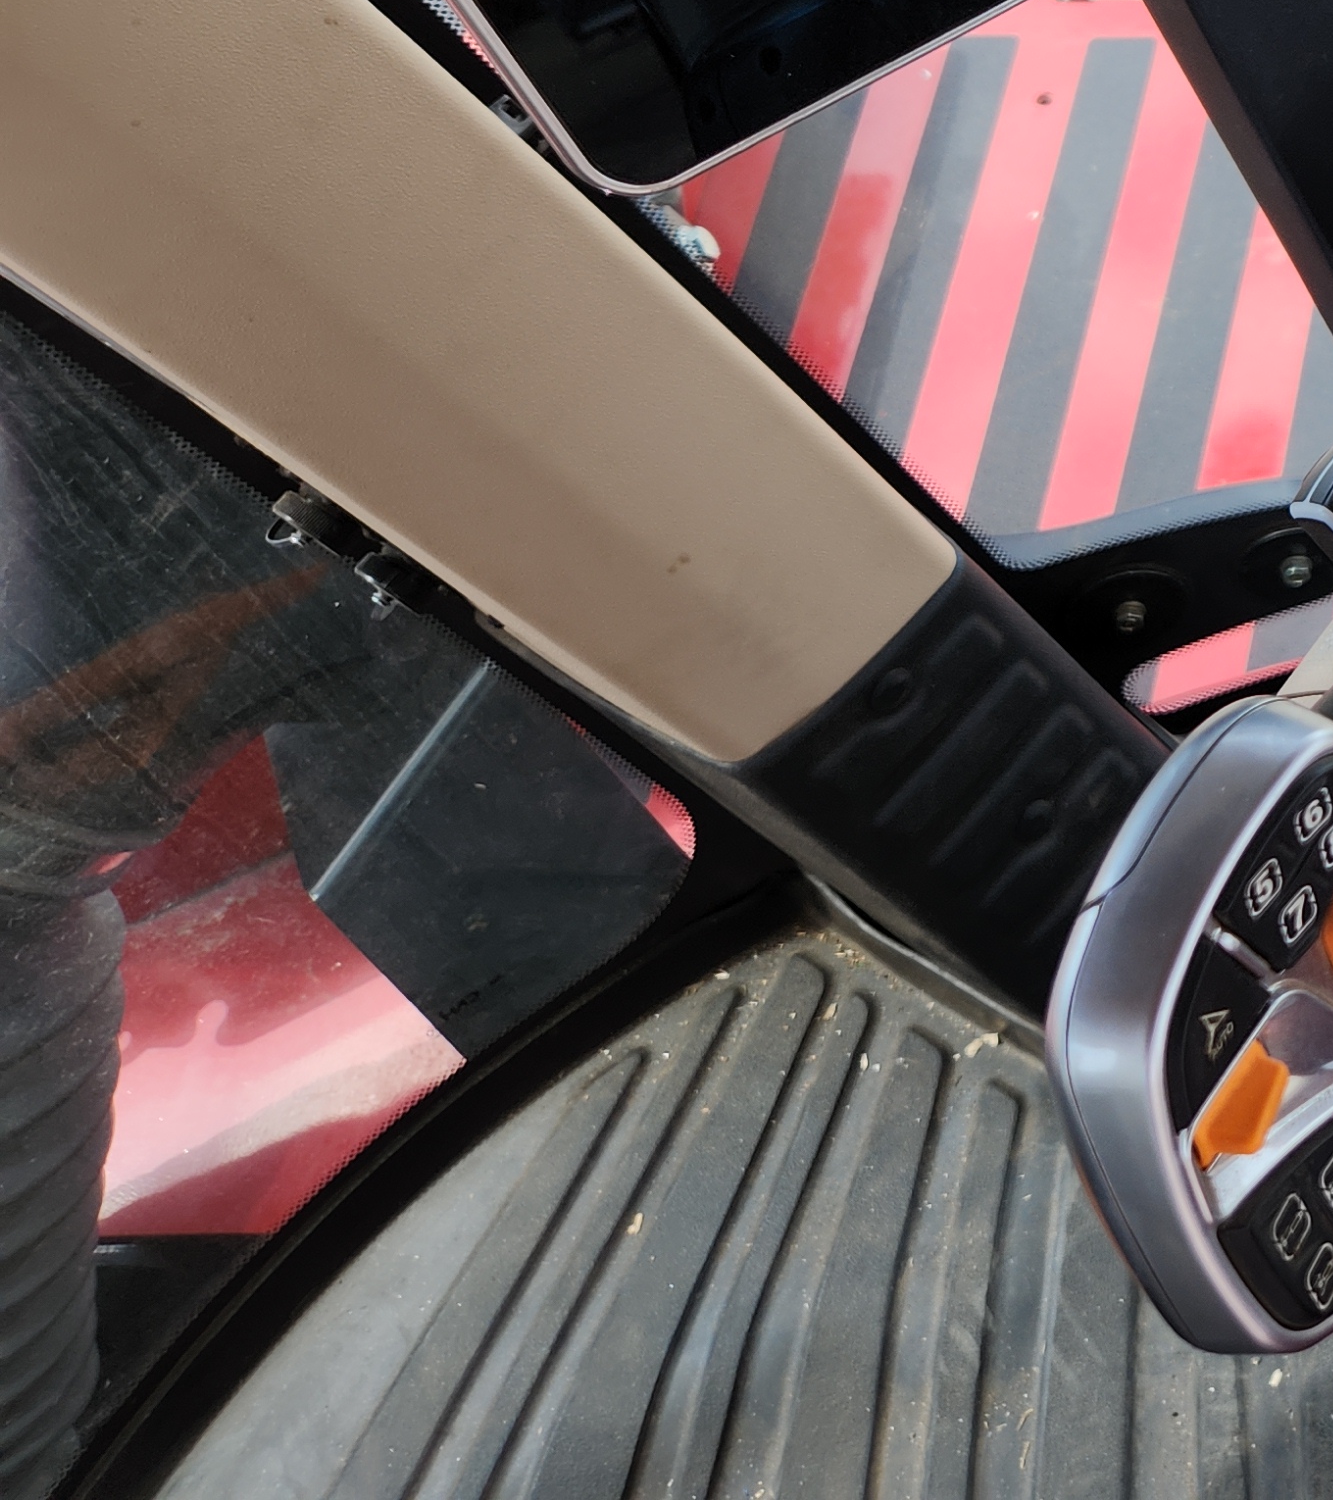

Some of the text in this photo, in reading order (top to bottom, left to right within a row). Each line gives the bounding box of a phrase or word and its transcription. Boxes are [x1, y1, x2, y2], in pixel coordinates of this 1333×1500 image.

[1303, 799, 1323, 829] 6
[1256, 868, 1274, 904] 5
[1287, 893, 1306, 931] 7
[1208, 1020, 1235, 1060] AUTO
